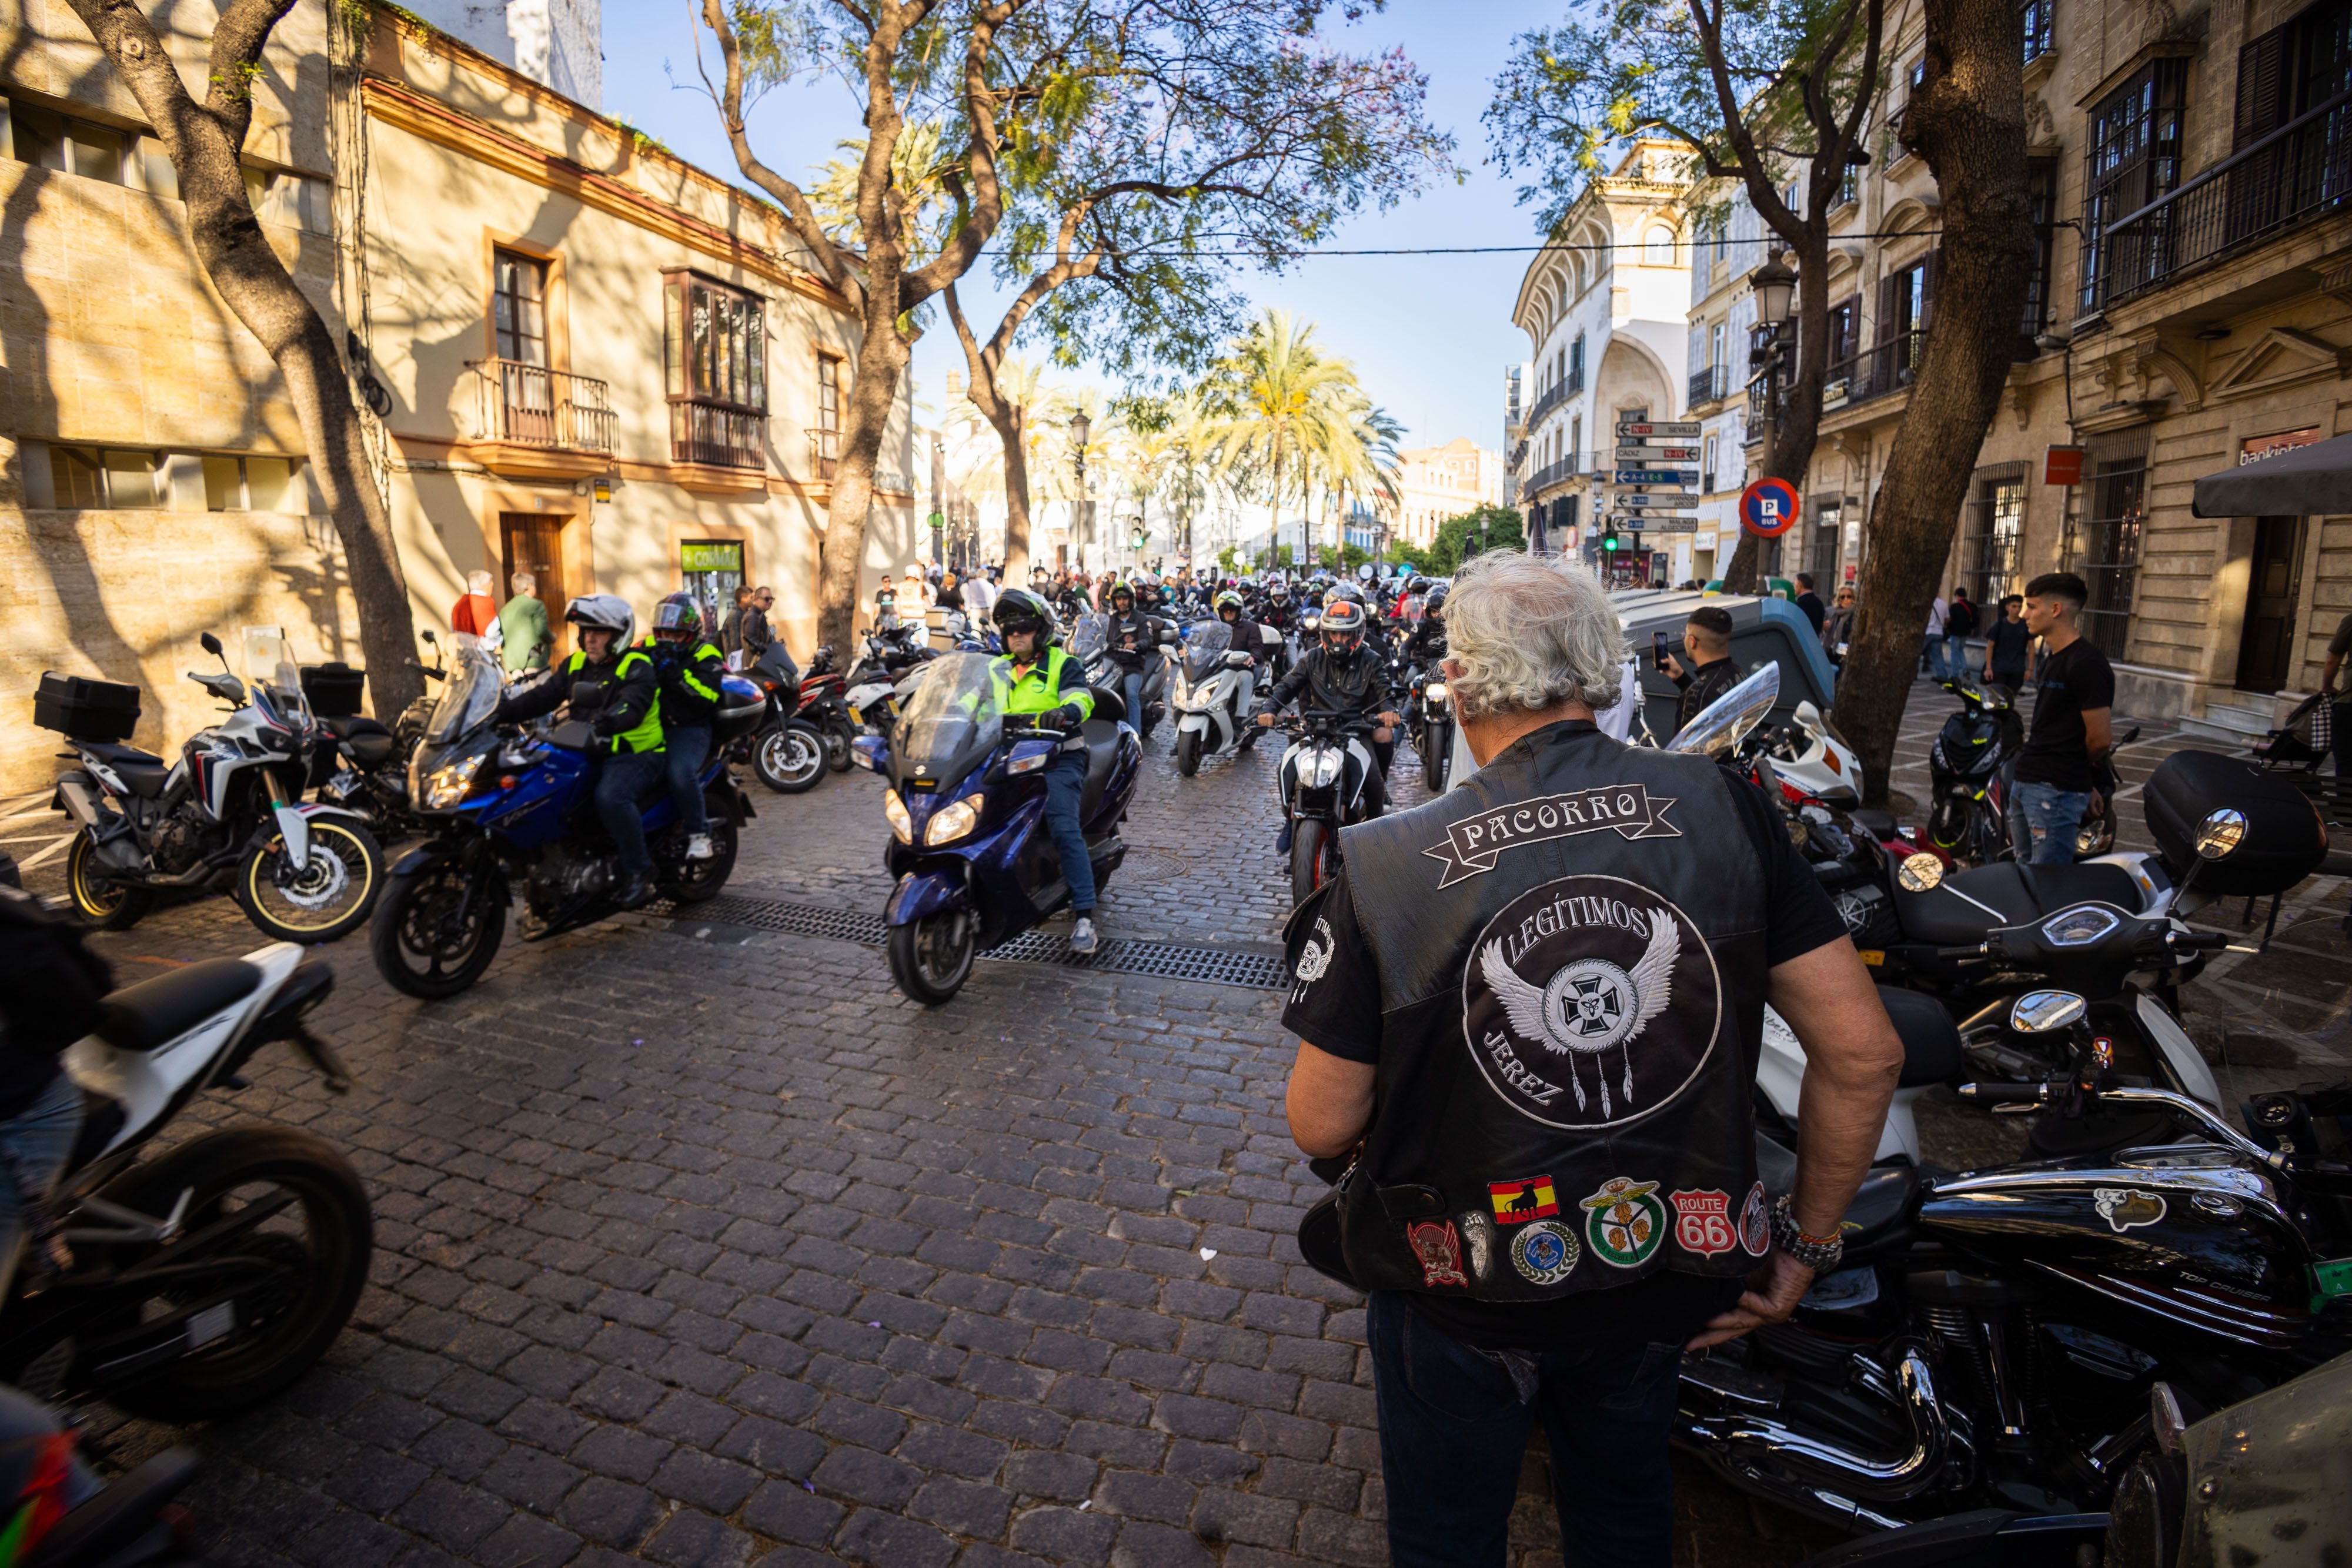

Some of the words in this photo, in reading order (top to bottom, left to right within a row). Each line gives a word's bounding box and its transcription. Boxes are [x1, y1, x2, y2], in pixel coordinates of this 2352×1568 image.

[1766, 502, 1774, 513] P
[1462, 794, 1637, 850] PACORRO
[1507, 892, 1649, 967] LEGÍTIMOS
[1484, 1030, 1564, 1106] JEREZ
[1679, 1198, 1723, 1211] ROUTE
[1682, 1215, 1728, 1248] 66
[2179, 1271, 2208, 1283] TOP
[2209, 1281, 2273, 1303] CRUISER
